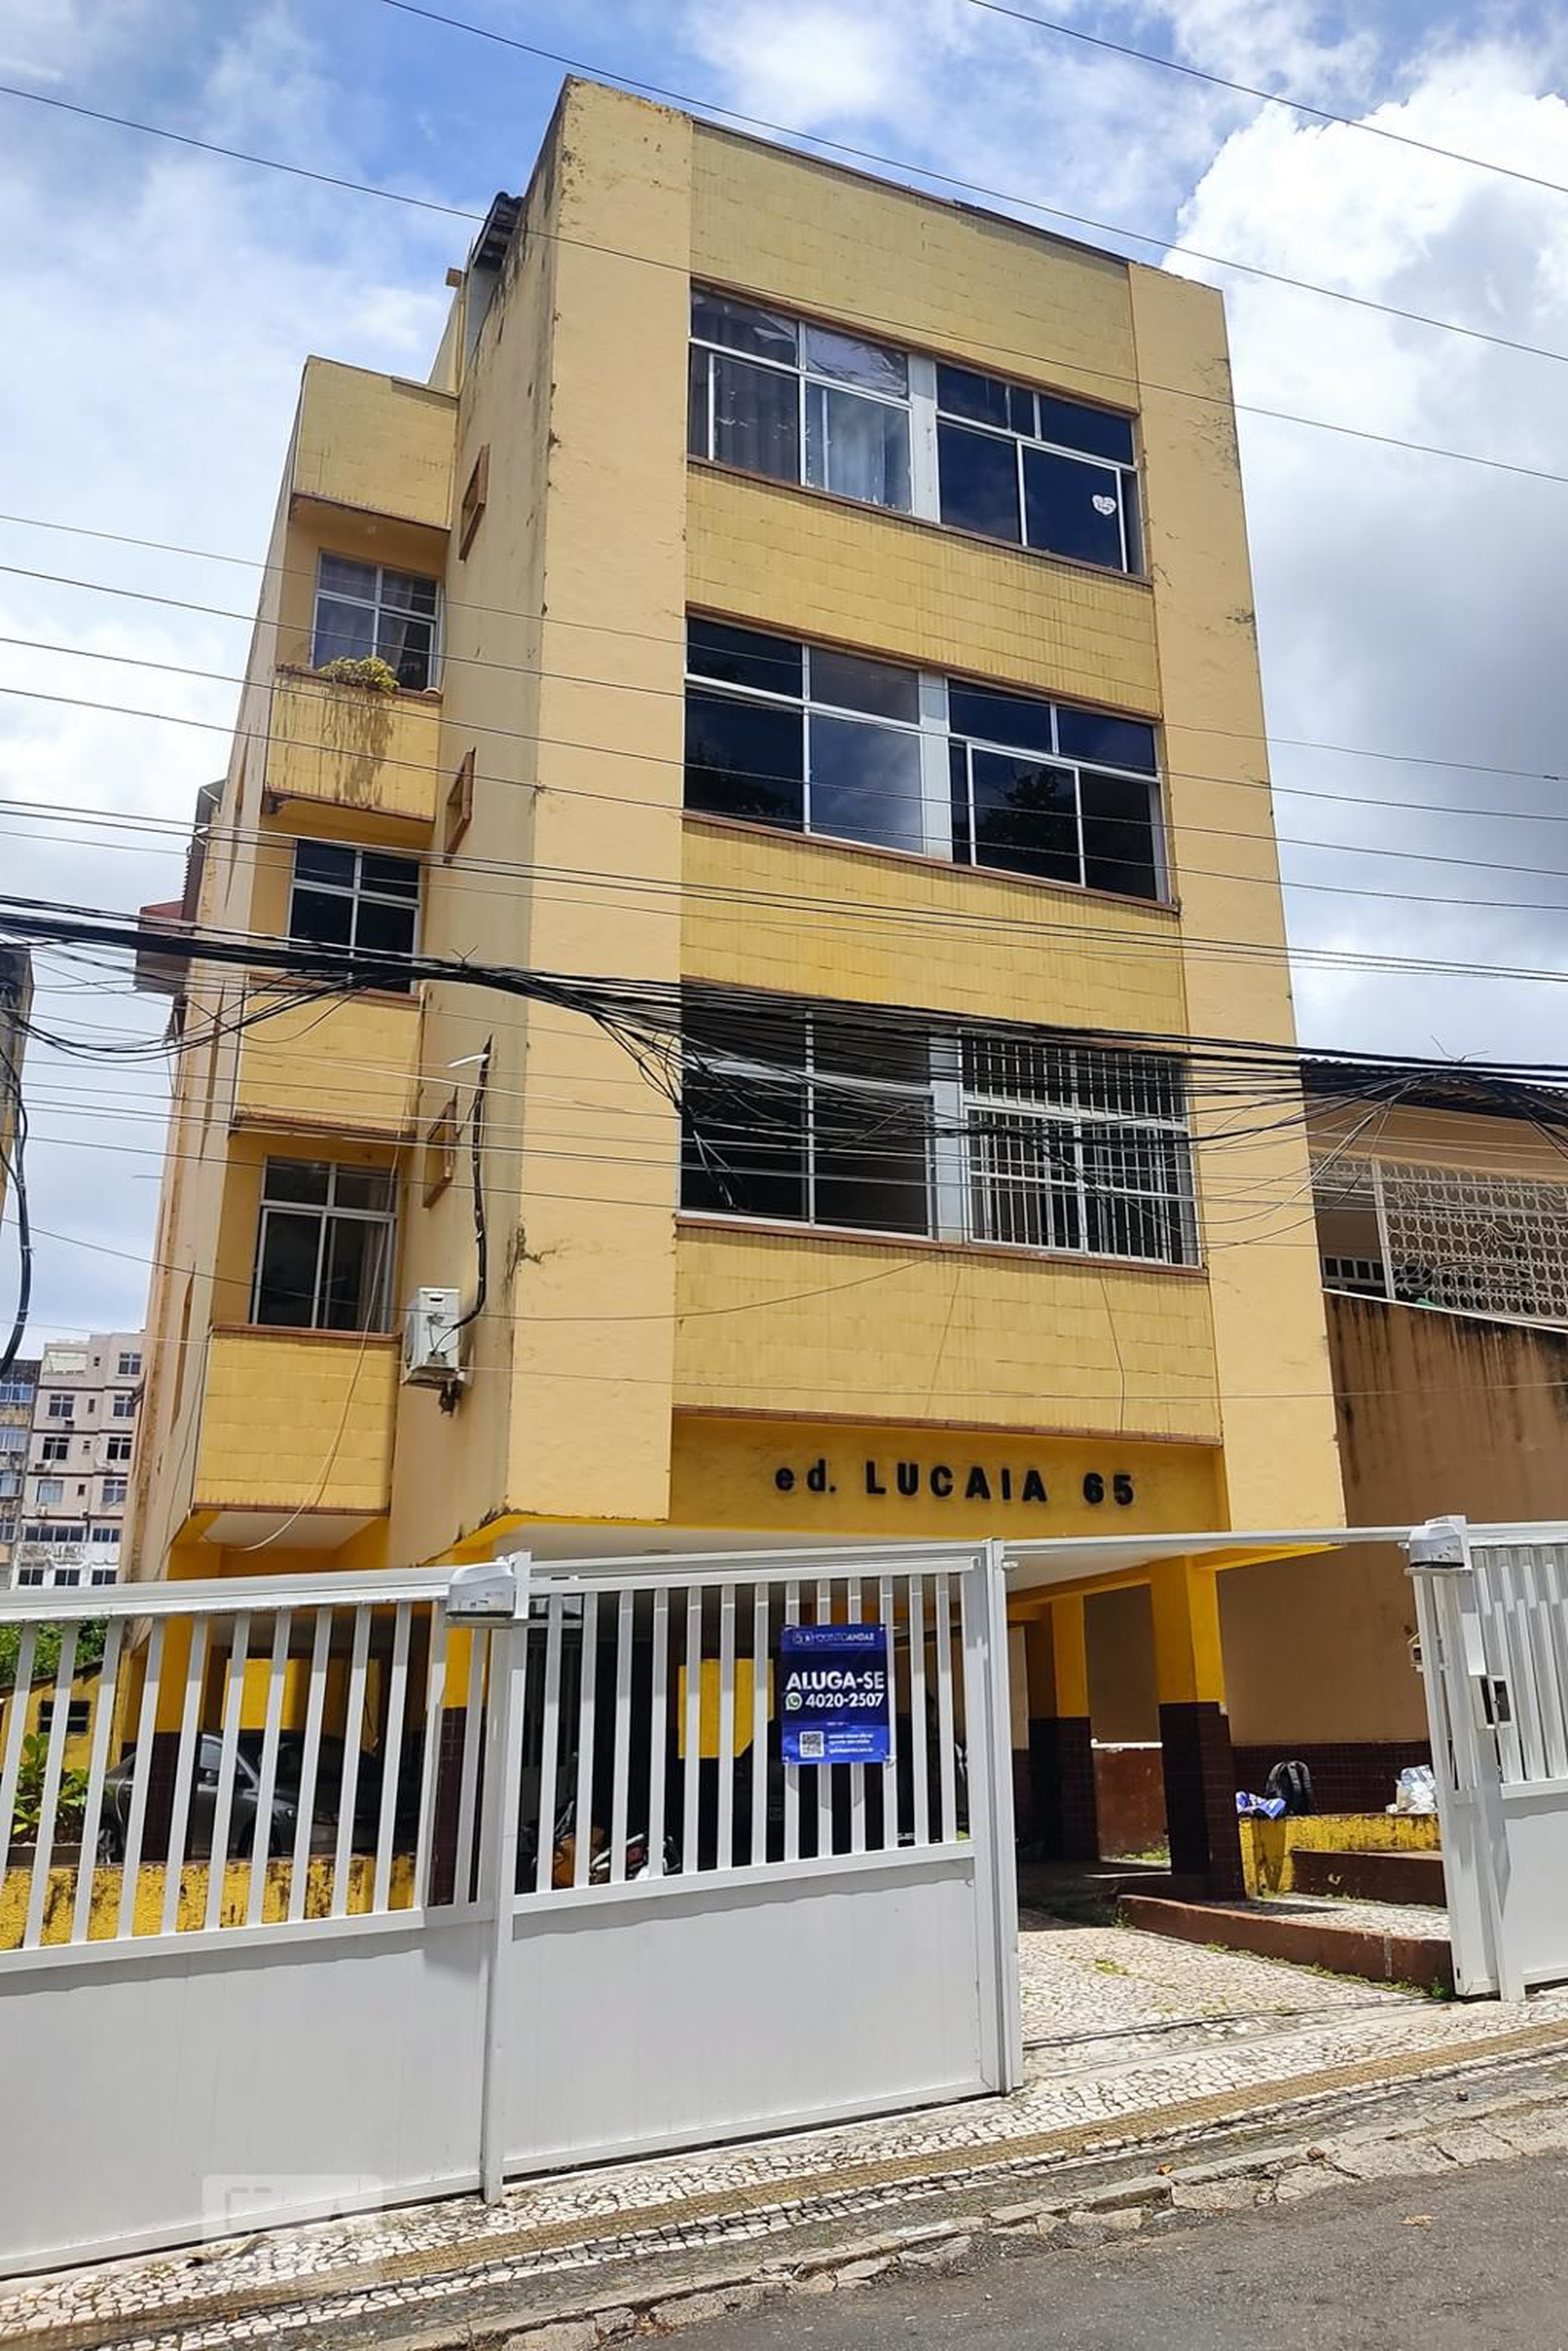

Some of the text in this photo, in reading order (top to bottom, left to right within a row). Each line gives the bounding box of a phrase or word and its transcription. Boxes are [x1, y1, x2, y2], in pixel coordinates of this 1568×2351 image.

[775, 1458, 1134, 1506] ed. LUCAIA 65
[786, 1671, 884, 1690] ALUGA-SE
[805, 1693, 884, 1708] 4020-2507
